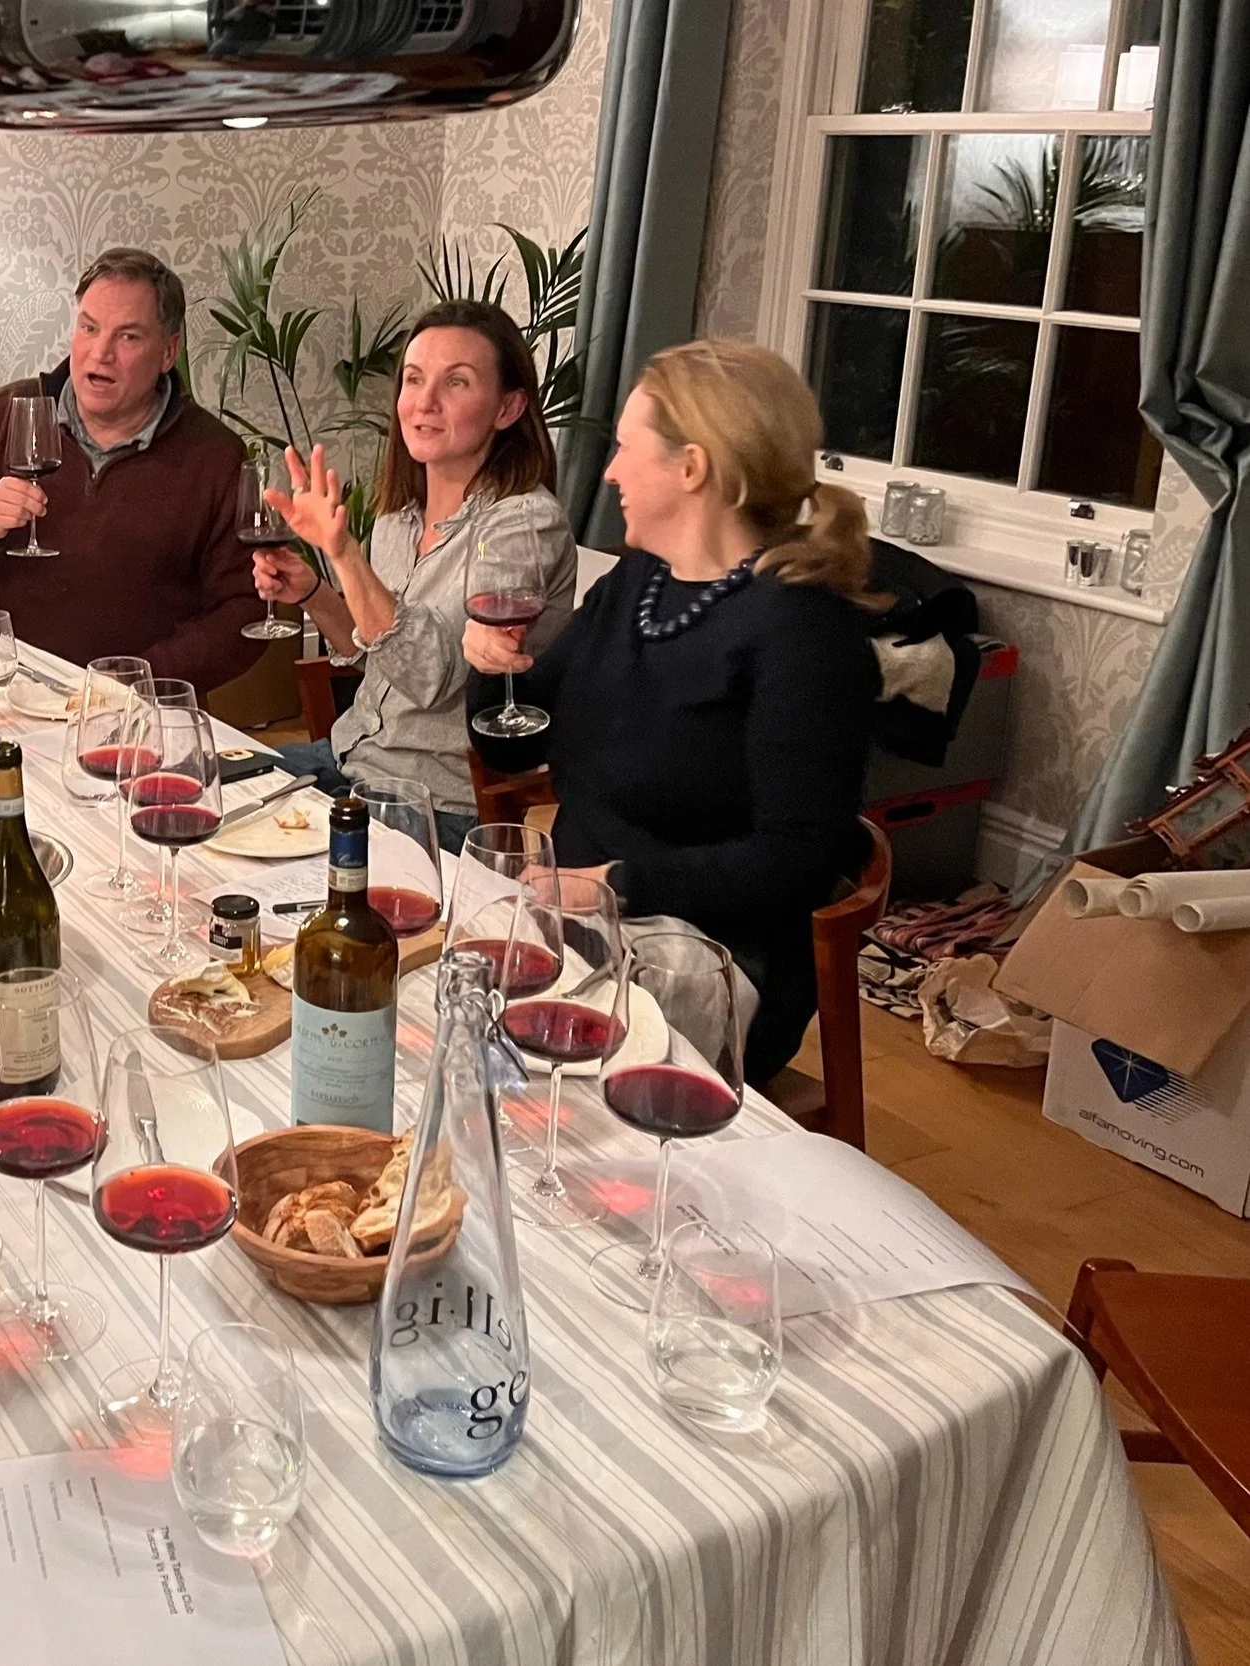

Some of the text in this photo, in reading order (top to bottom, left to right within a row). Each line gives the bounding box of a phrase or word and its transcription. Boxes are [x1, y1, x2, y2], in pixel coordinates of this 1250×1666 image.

[1078, 1108, 1205, 1179] alfamoving.com
[160, 1525, 170, 1540] The
[182, 1594, 195, 1615] Club
